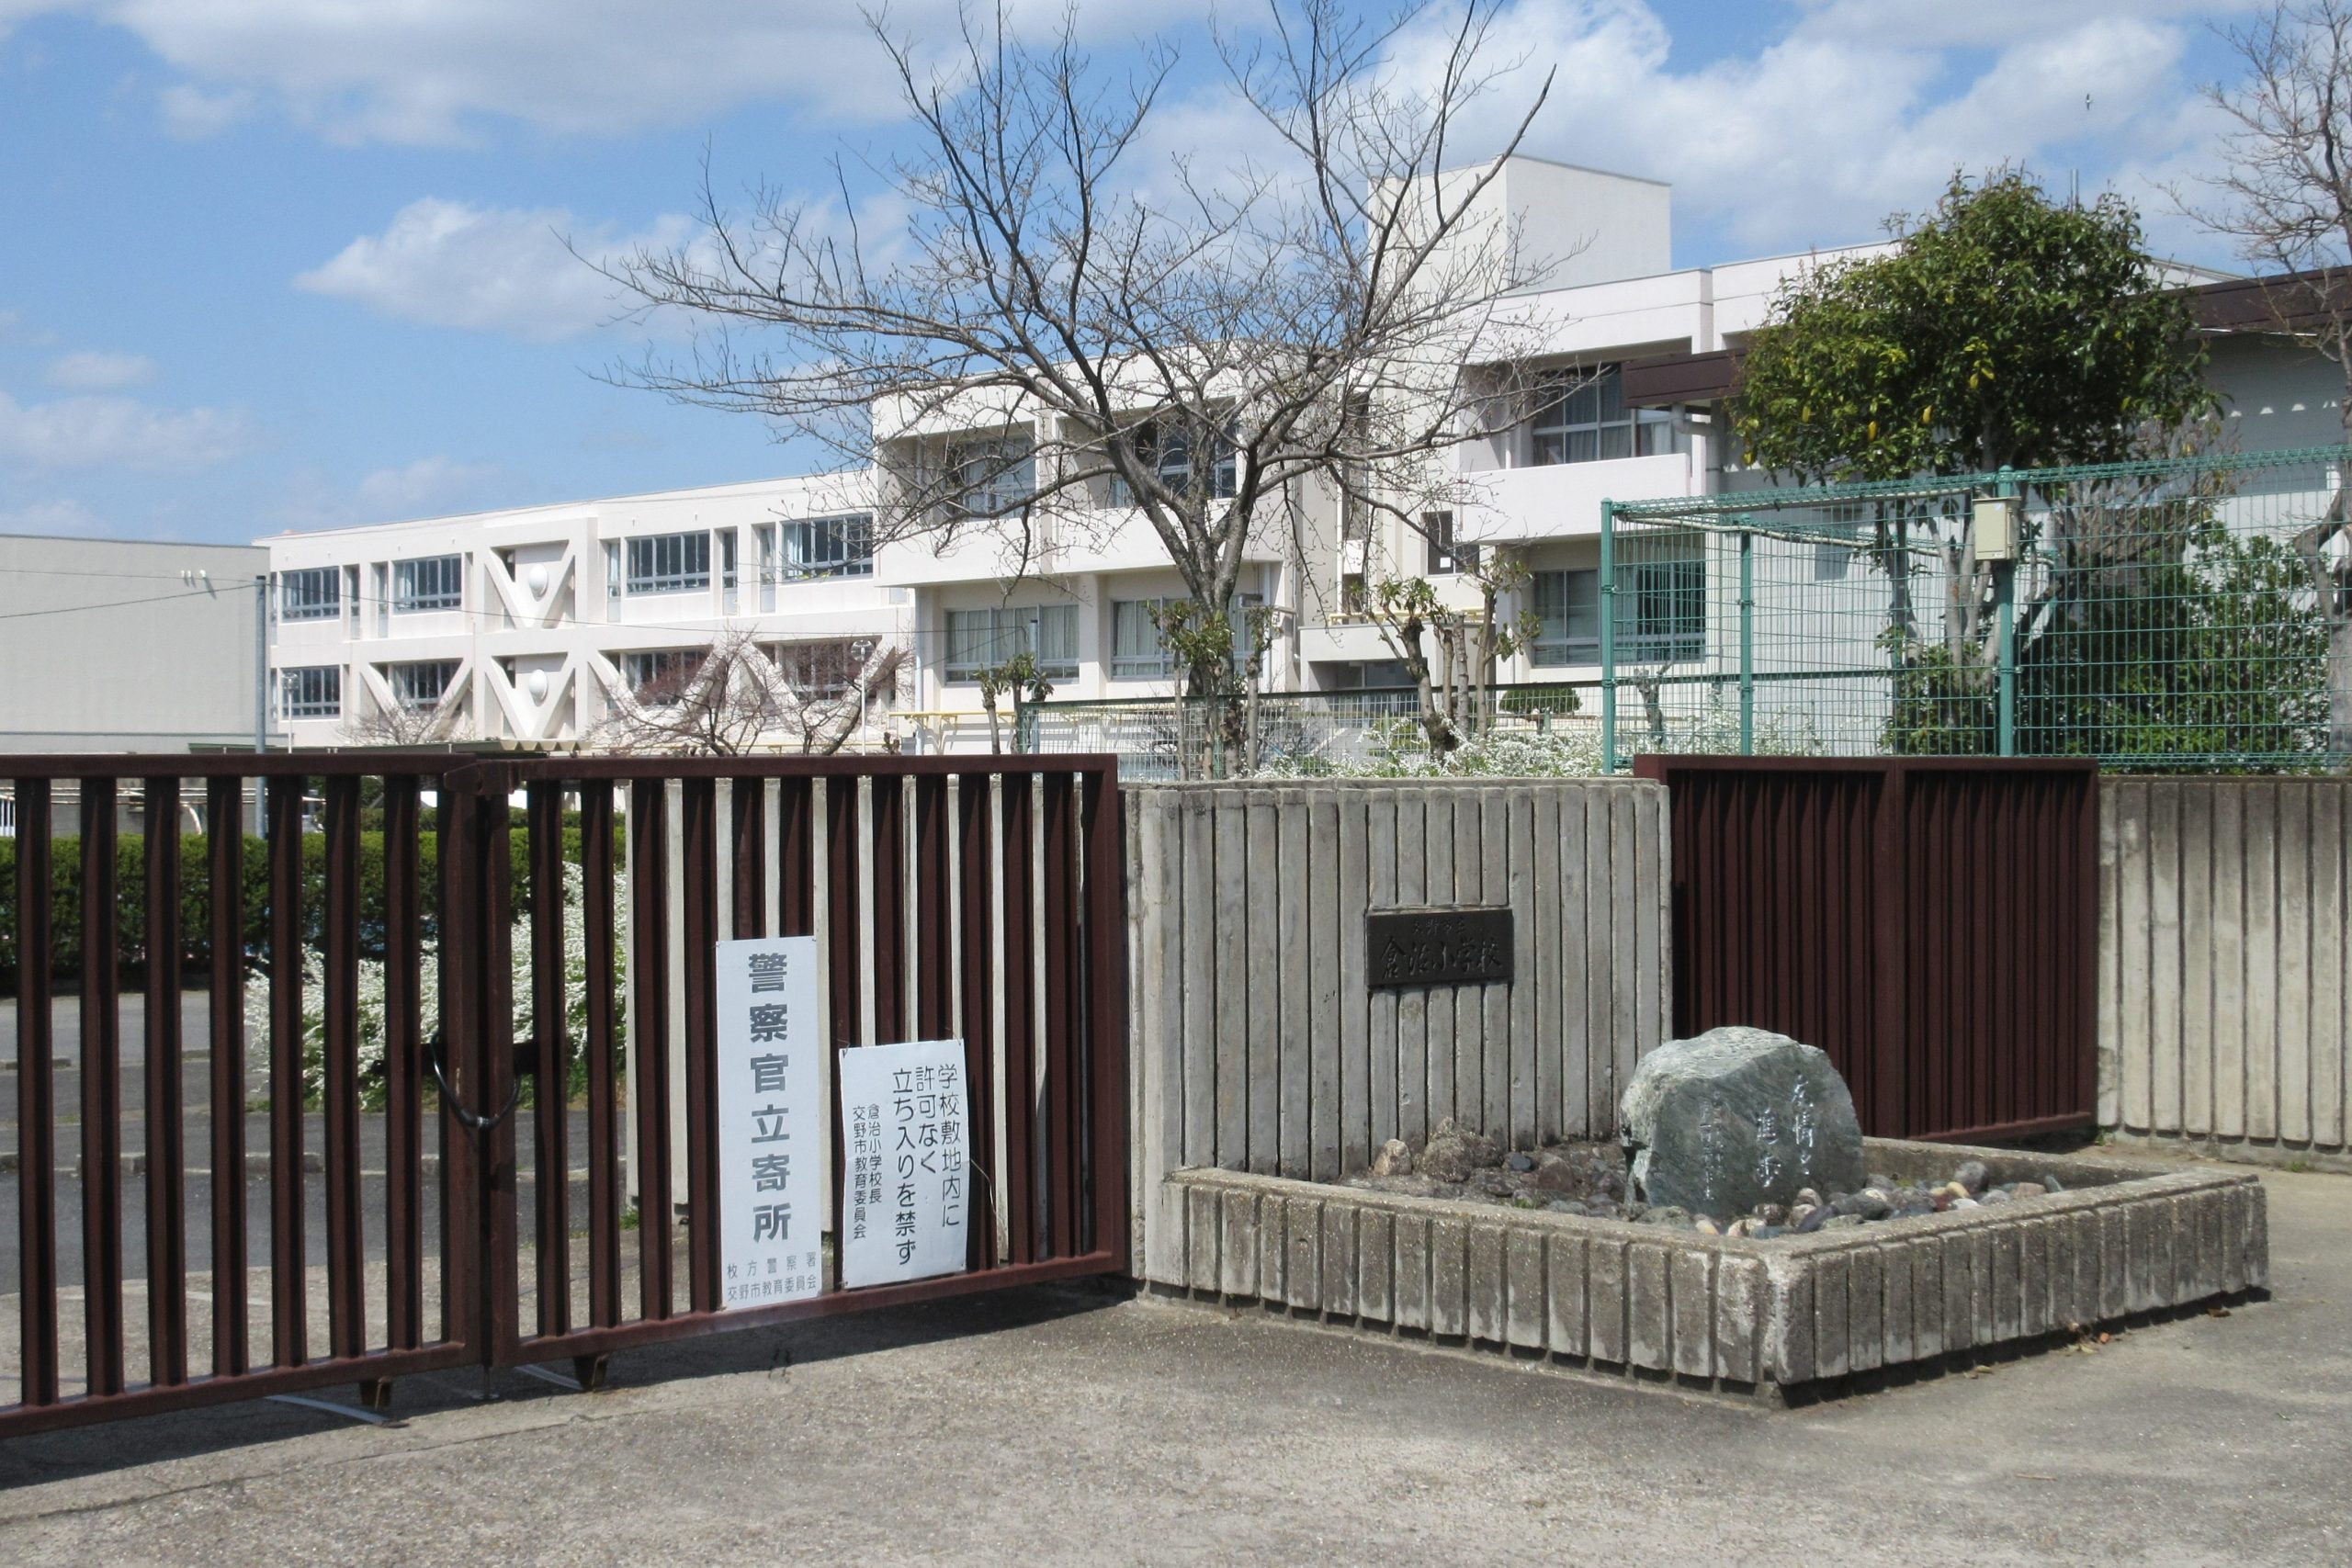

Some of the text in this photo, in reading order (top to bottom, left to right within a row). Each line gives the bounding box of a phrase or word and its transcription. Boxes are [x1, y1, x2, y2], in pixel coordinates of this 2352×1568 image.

[748, 952, 790, 1243] 警察官立寄所
[867, 1103, 883, 1204] 倉治小学校長
[915, 1066, 938, 1174] 許可なく
[937, 1064, 961, 1227] 学校敷地内に
[853, 1105, 867, 1240] 交野市教育委員会
[892, 1067, 916, 1266] 立ち入りを禁ず
[727, 1251, 817, 1280] 枚方警察署
[727, 1274, 817, 1302] 交野市教育委員会
